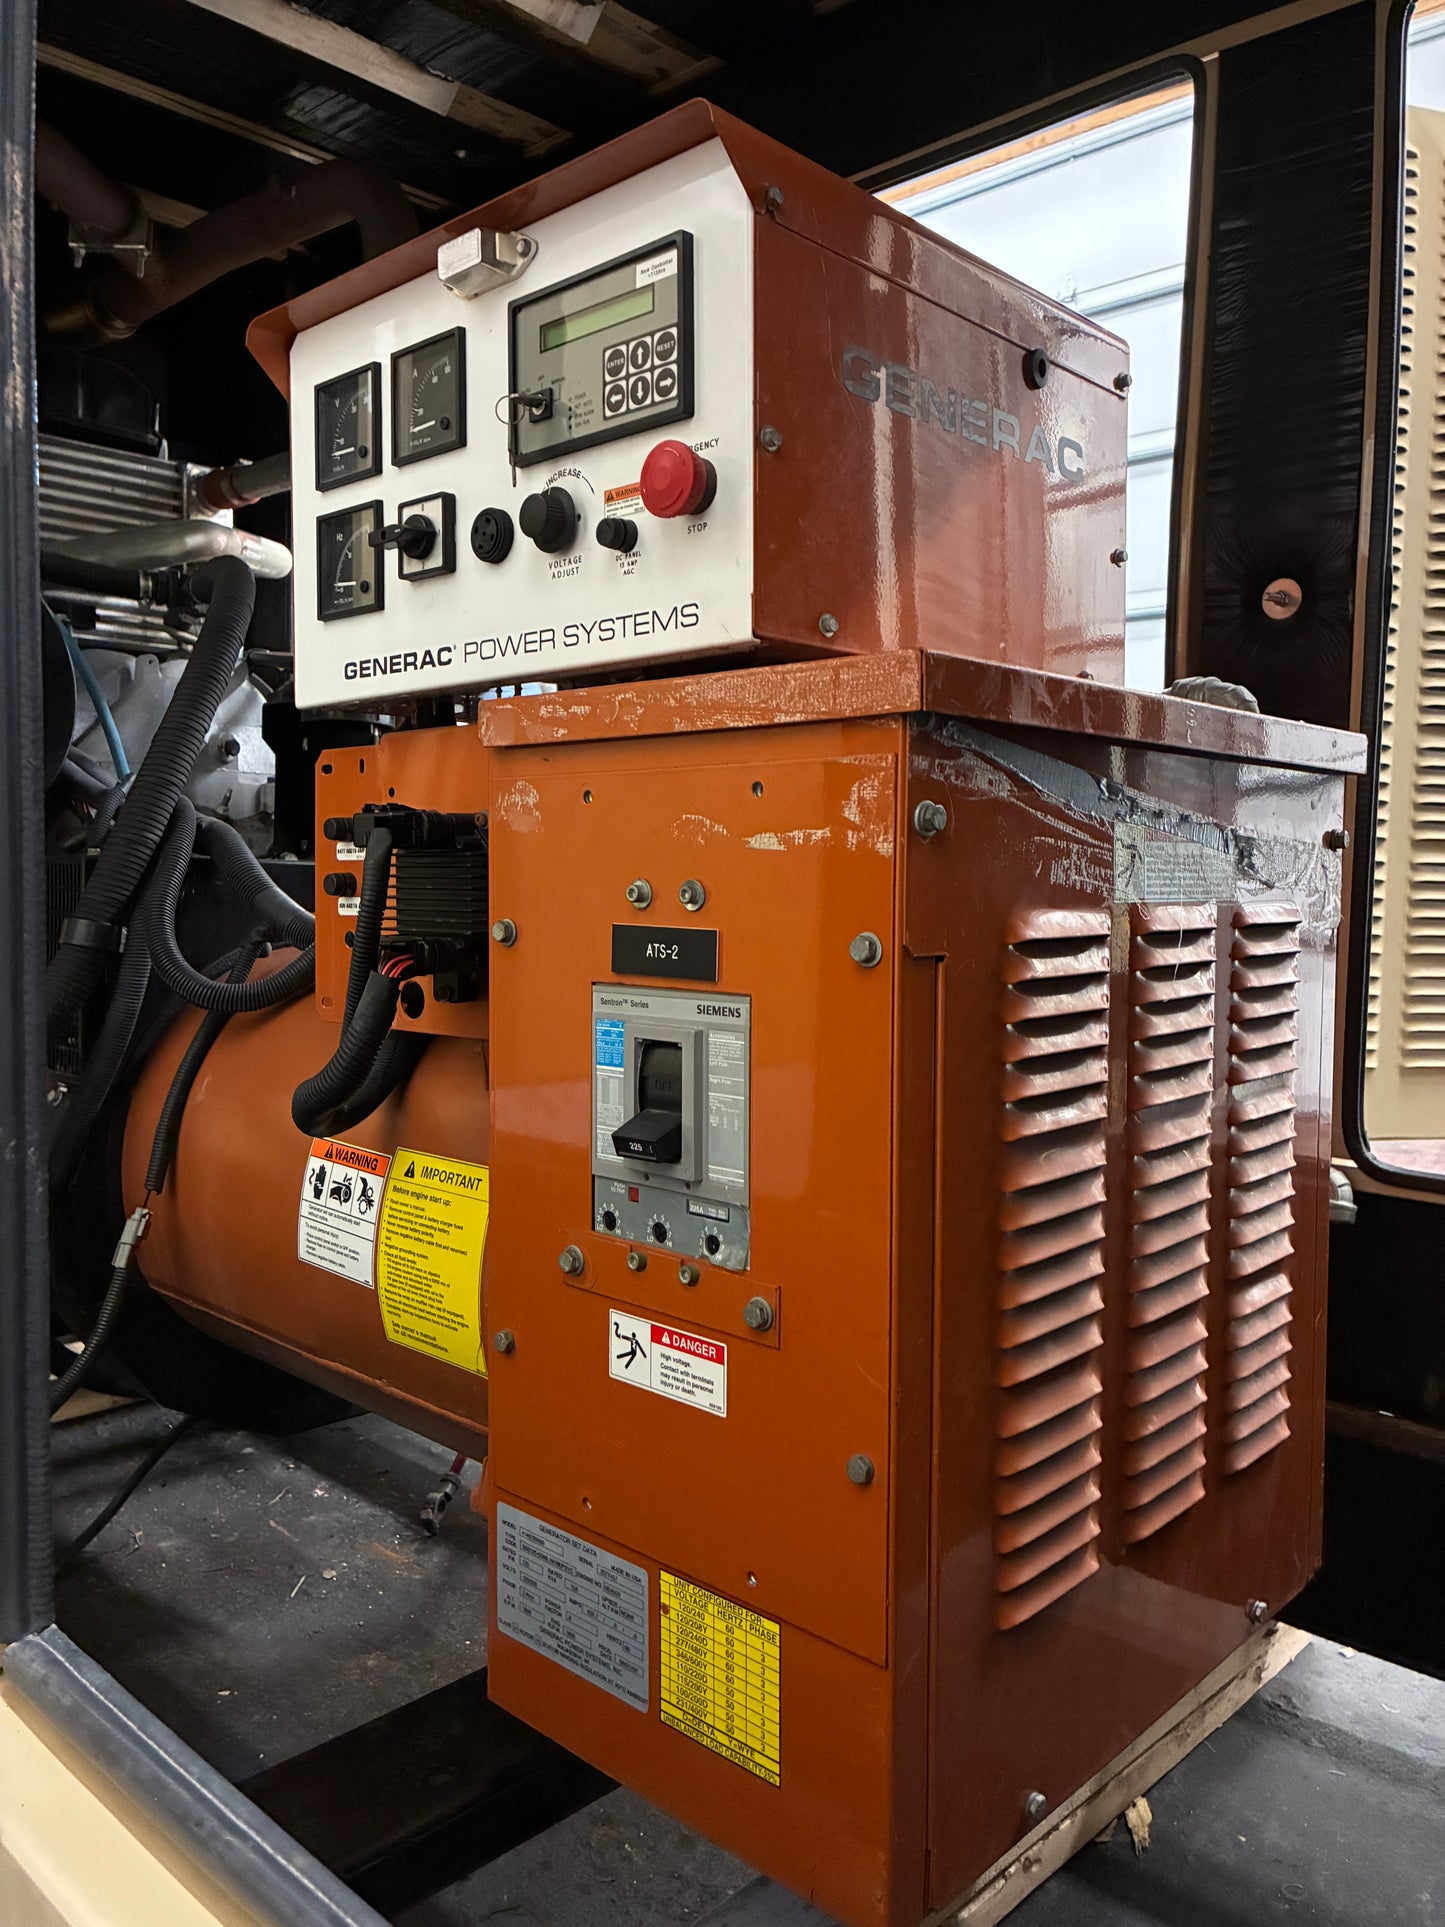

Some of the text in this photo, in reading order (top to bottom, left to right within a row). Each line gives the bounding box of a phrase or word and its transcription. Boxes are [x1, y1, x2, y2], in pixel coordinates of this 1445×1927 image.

[657, 340, 674, 352] RESET
[413, 369, 417, 378] A
[607, 358, 625, 368] ENTER
[335, 399, 339, 408] V
[843, 344, 1084, 482] GENERAC
[545, 468, 582, 487] INCREASE
[687, 522, 708, 535] STOP
[548, 555, 583, 570] VOLTAGE
[615, 550, 641, 562] DC PANEL
[552, 567, 579, 580] ADJUST
[623, 567, 634, 576] AGC
[344, 603, 699, 680] GENERAC POWER SYSTEMS
[647, 943, 678, 959] ATS-2
[630, 1000, 649, 1009] Series
[697, 1005, 741, 1018] SIEMENS
[629, 1142, 642, 1151] 225
[334, 1148, 378, 1171] WARNING
[421, 1166, 482, 1191] IMPORTANT
[393, 1185, 409, 1195] Before
[410, 1191, 428, 1201] engine
[429, 1196, 442, 1204] start
[690, 1204, 704, 1214] 225A
[673, 1335, 716, 1358] DANGER
[661, 1353, 691, 1368] High voltage.
[660, 1363, 679, 1374] Contact
[691, 1373, 714, 1385] terminals
[660, 1372, 670, 1380] may
[672, 1375, 685, 1383] result
[692, 1382, 713, 1394] personal
[660, 1380, 673, 1390] injury
[681, 1386, 696, 1396] death.
[674, 1578, 764, 1627] UNIT CONFIGURED FOR:
[674, 1588, 777, 1643] VOLTAGE HERTZ PHASE
[679, 1602, 764, 1650] 120/240 60 1
[677, 1613, 765, 1663] 120/208Y 60 3
[677, 1625, 765, 1675] 120/240D 60 3
[676, 1637, 765, 1688] 277/480Y 60 3
[676, 1649, 765, 1701] 346/600Y 60 3
[677, 1662, 708, 1683] 110/220D
[725, 1687, 734, 1697] 50
[677, 1674, 765, 1727] 115/200Y 50 3
[677, 1686, 765, 1740] 100/200D 50 3
[663, 1714, 704, 1743] UNBALANCED
[706, 1740, 723, 1754] LOAD
[676, 1697, 765, 1752] 231/400Y 50 3
[728, 1737, 755, 1759] Y=WYE
